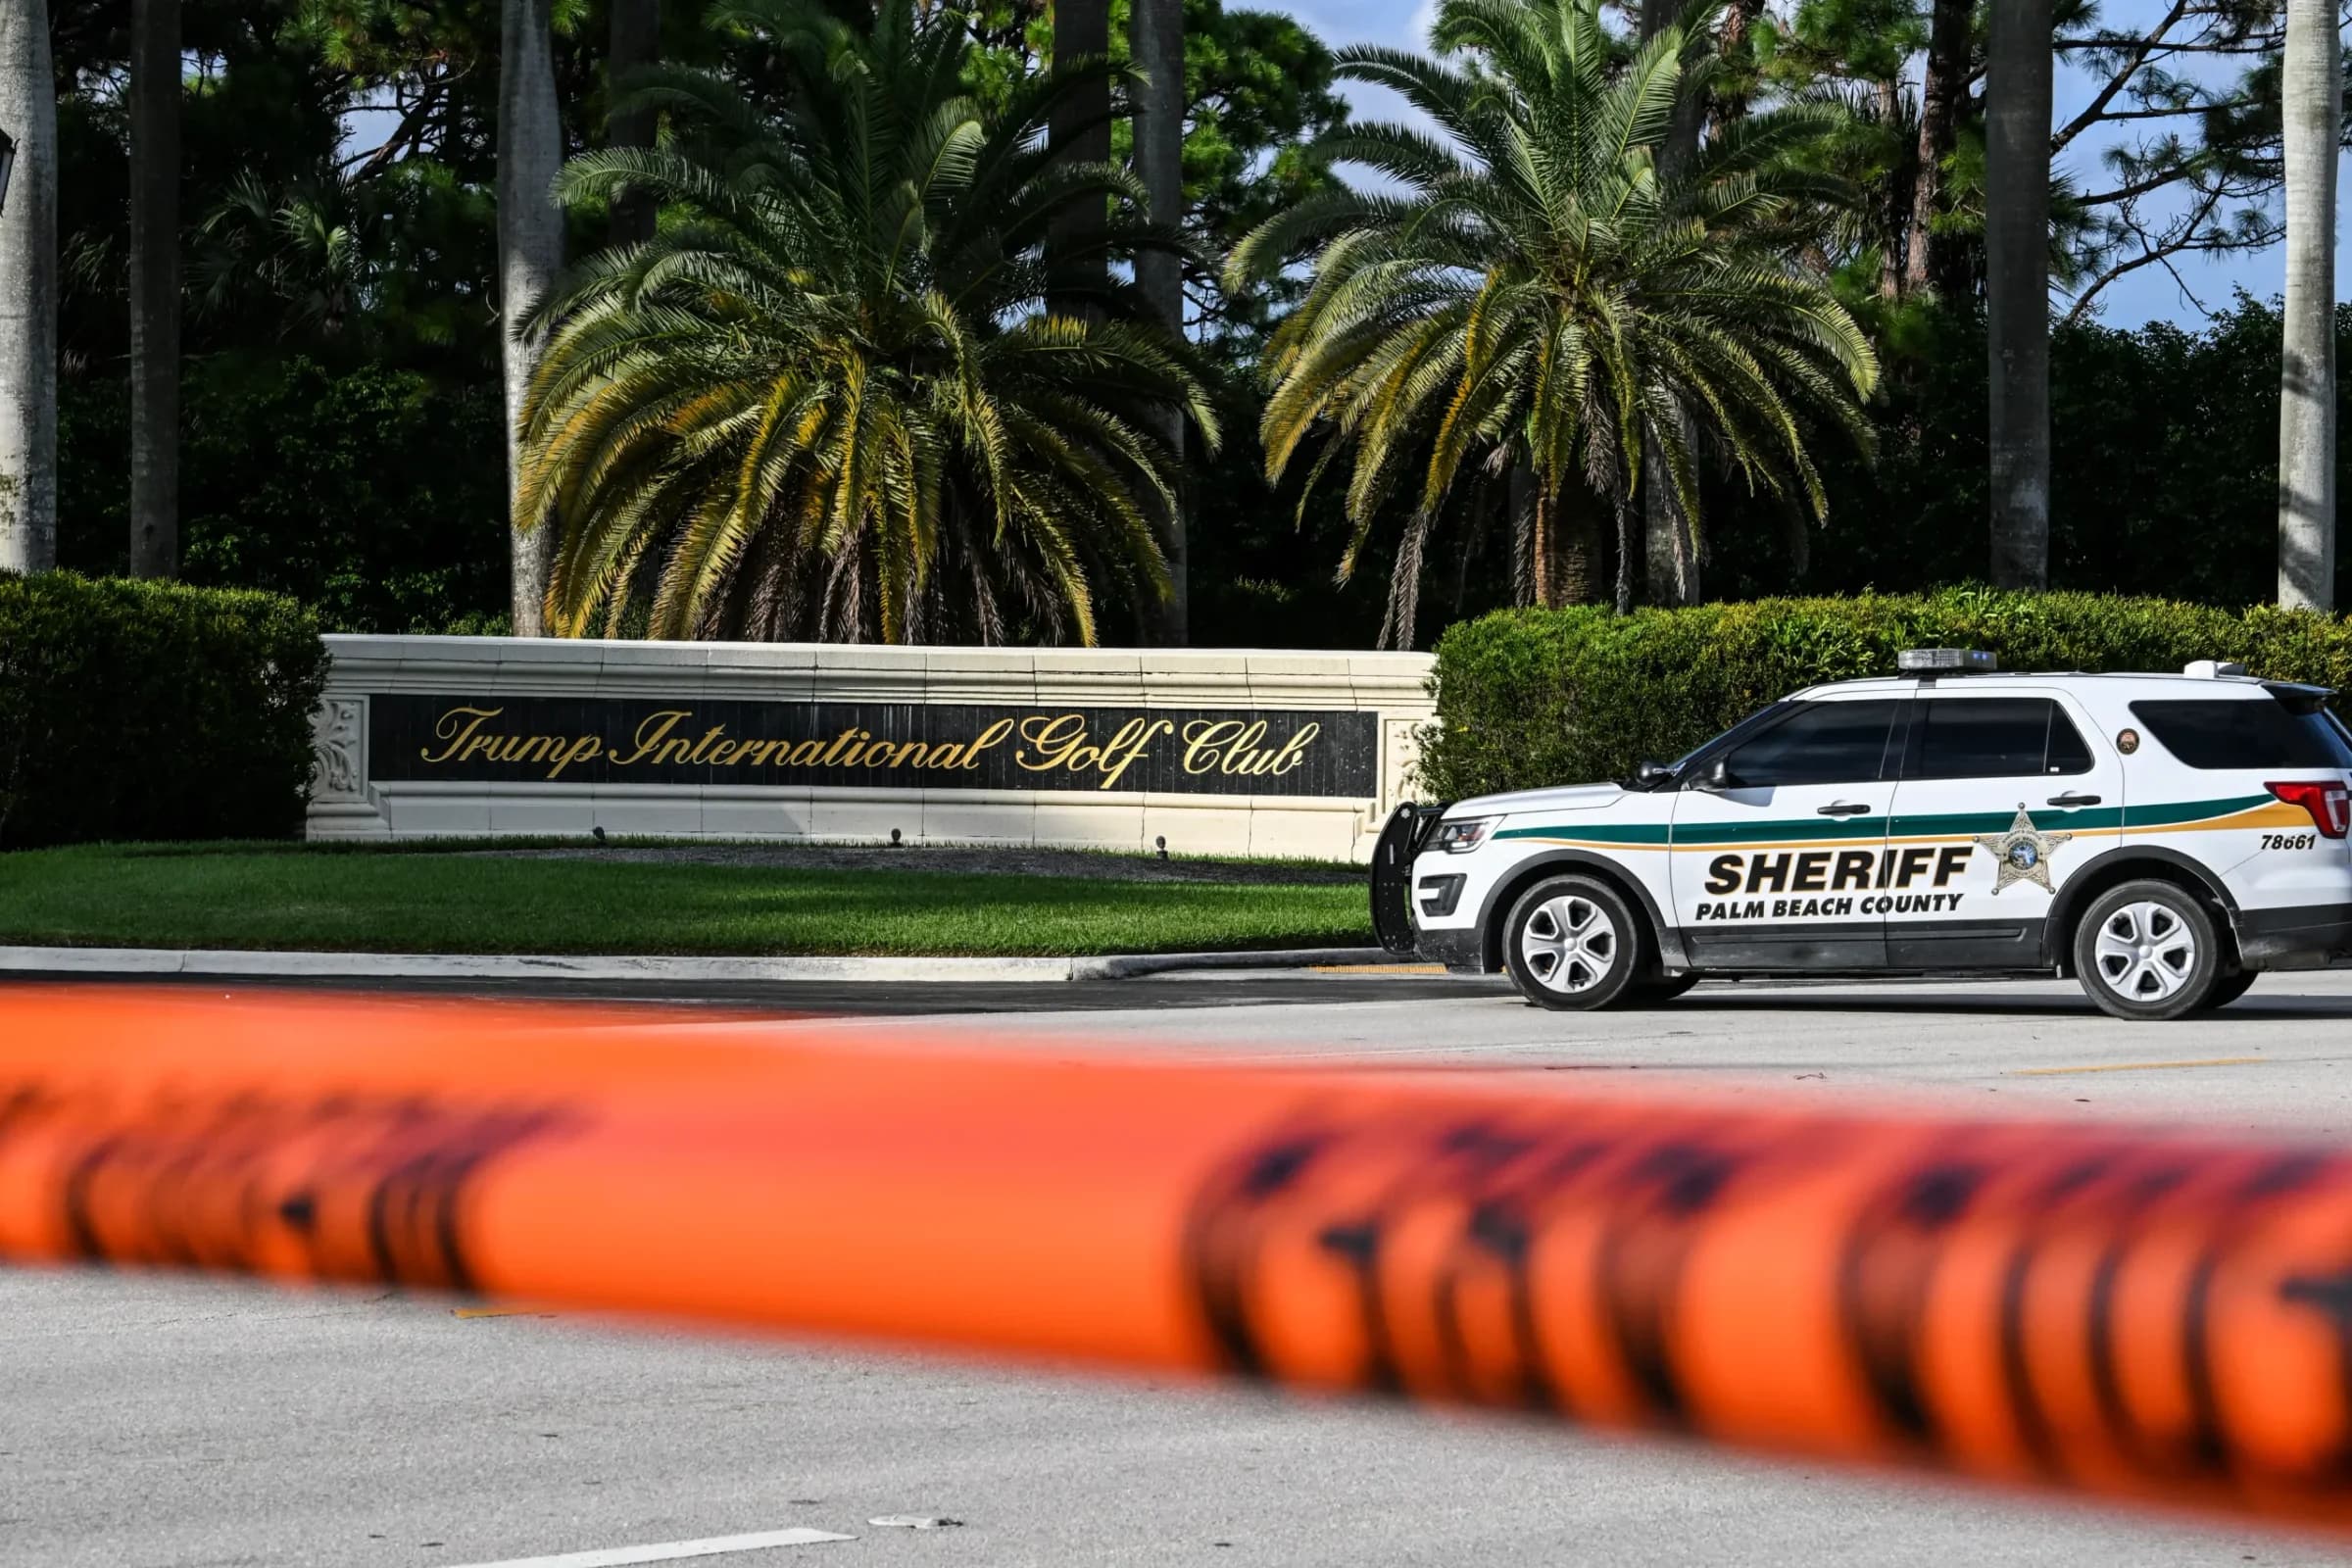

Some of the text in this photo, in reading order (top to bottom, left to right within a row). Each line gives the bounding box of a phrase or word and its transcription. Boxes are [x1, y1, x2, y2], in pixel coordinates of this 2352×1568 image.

[420, 706, 1320, 790] Trump International Golf Club
[2261, 834, 2316, 851] 78661
[1703, 845, 1974, 896] SHERIFF
[1695, 893, 1964, 920] PALM BEACH COUNTY
